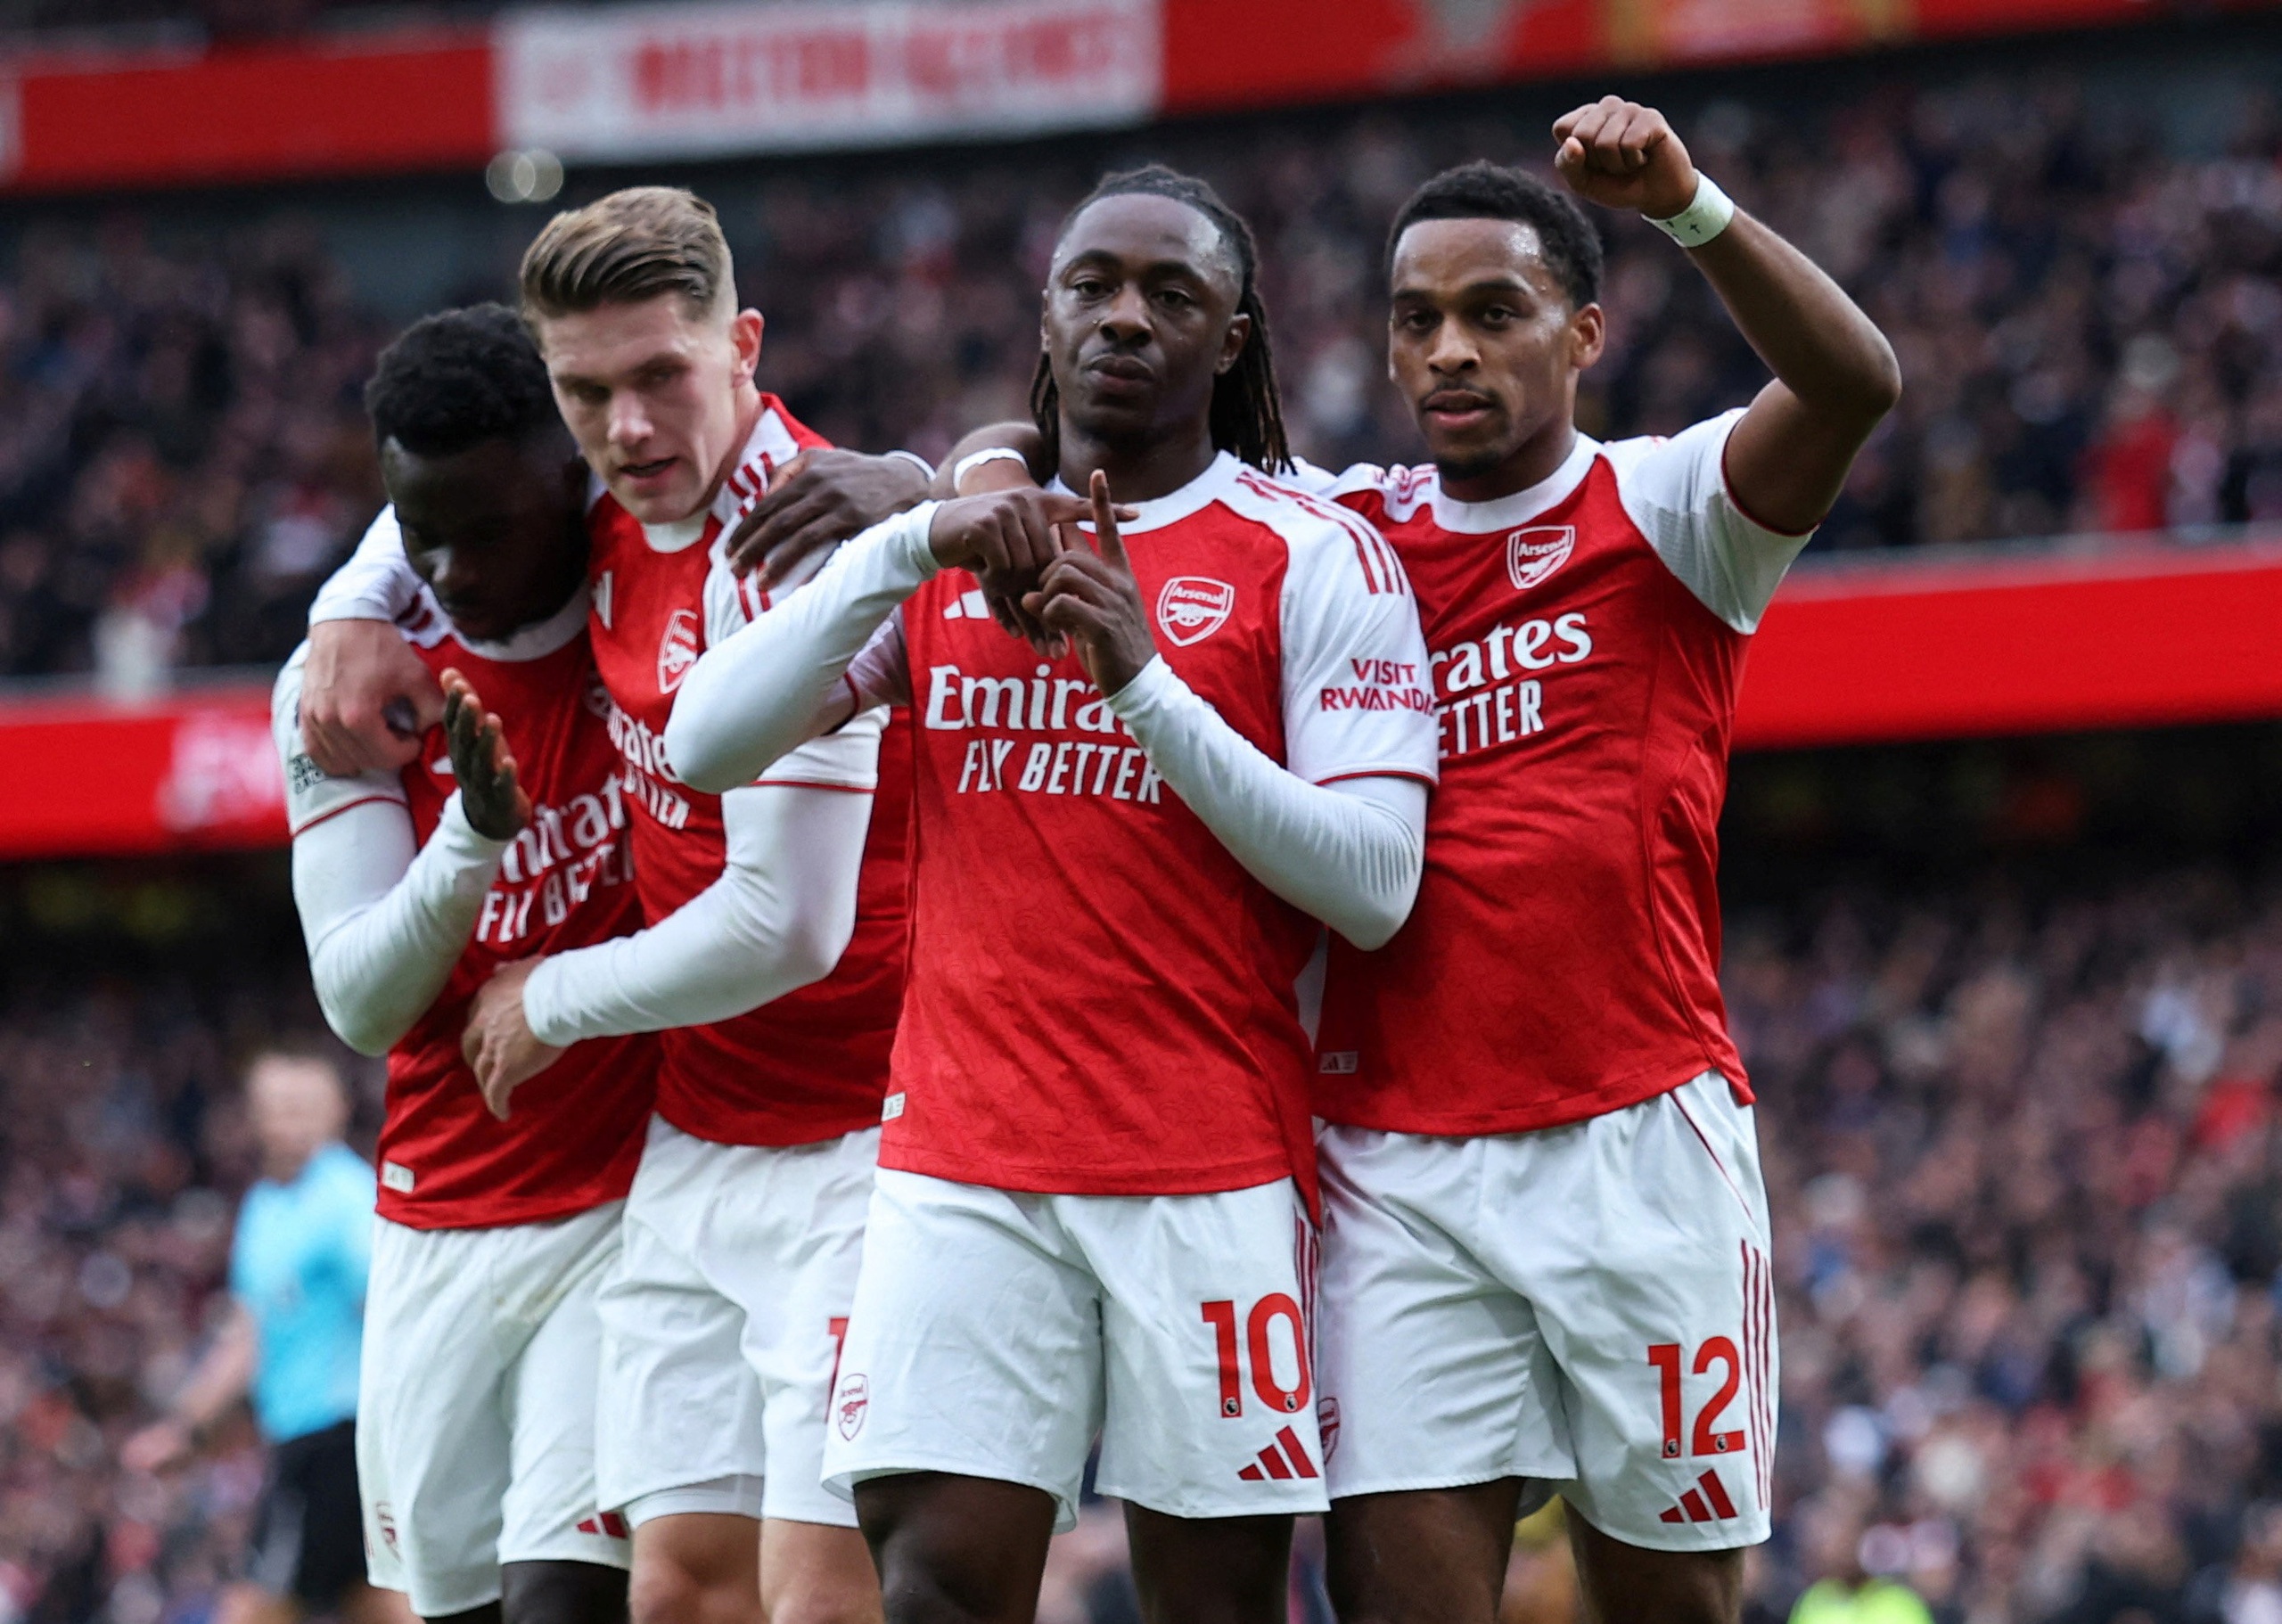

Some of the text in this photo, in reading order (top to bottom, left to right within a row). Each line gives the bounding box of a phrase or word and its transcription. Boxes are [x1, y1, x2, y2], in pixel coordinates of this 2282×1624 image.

[1350, 658, 1416, 685] VISIT
[1428, 612, 1592, 703] rates
[925, 663, 1133, 736] Emira
[1434, 679, 1545, 759] ETTER
[957, 738, 1161, 804] FLY BETTER
[1201, 1292, 1310, 1418] 10
[1647, 1335, 1746, 1459] 12
